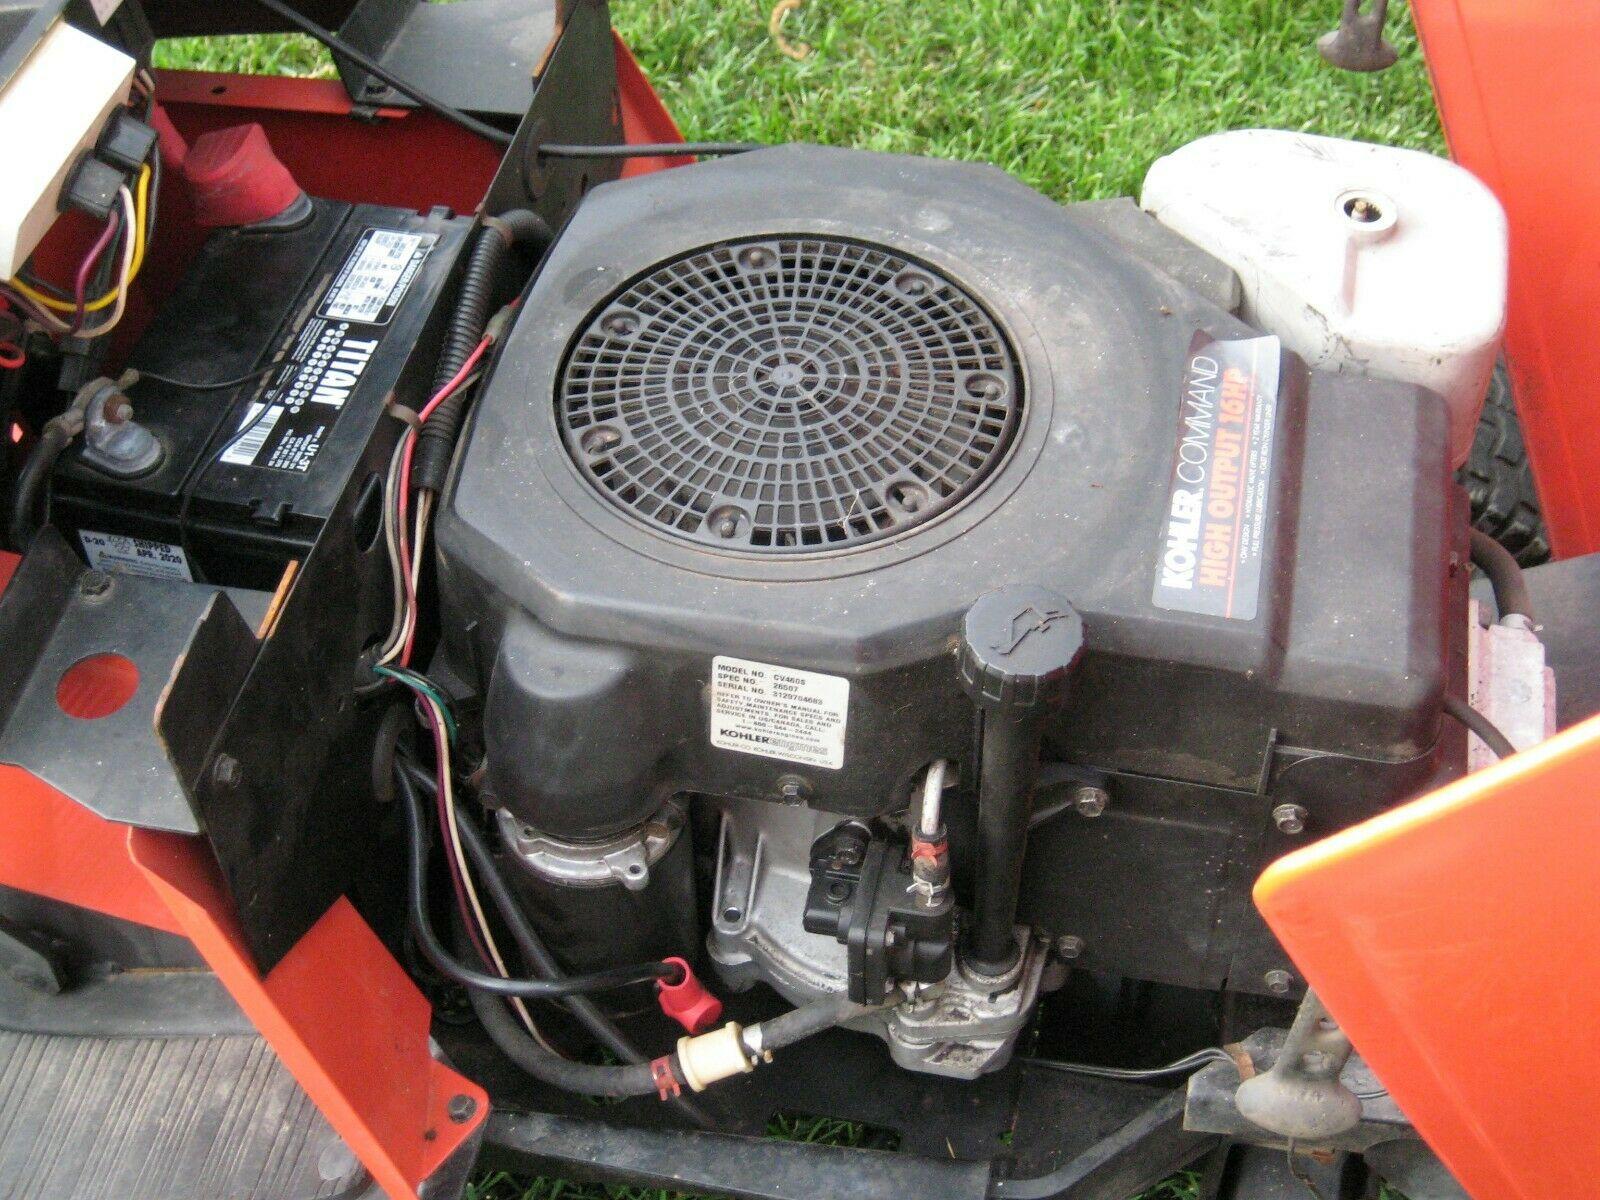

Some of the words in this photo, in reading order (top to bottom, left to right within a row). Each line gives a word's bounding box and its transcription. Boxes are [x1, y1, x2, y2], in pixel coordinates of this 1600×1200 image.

[310, 339, 378, 406] TITAN
[1218, 367, 1248, 424] 16HP
[1177, 356, 1218, 483] COMMAND
[1208, 427, 1242, 519] OUTPUT
[1199, 522, 1232, 586] HIGH
[717, 681, 748, 692] SERIAL
[718, 664, 749, 676] MODEL
[773, 674, 806, 686] CV460S
[718, 673, 740, 683] SPEC
[791, 705, 822, 714] MANUAL
